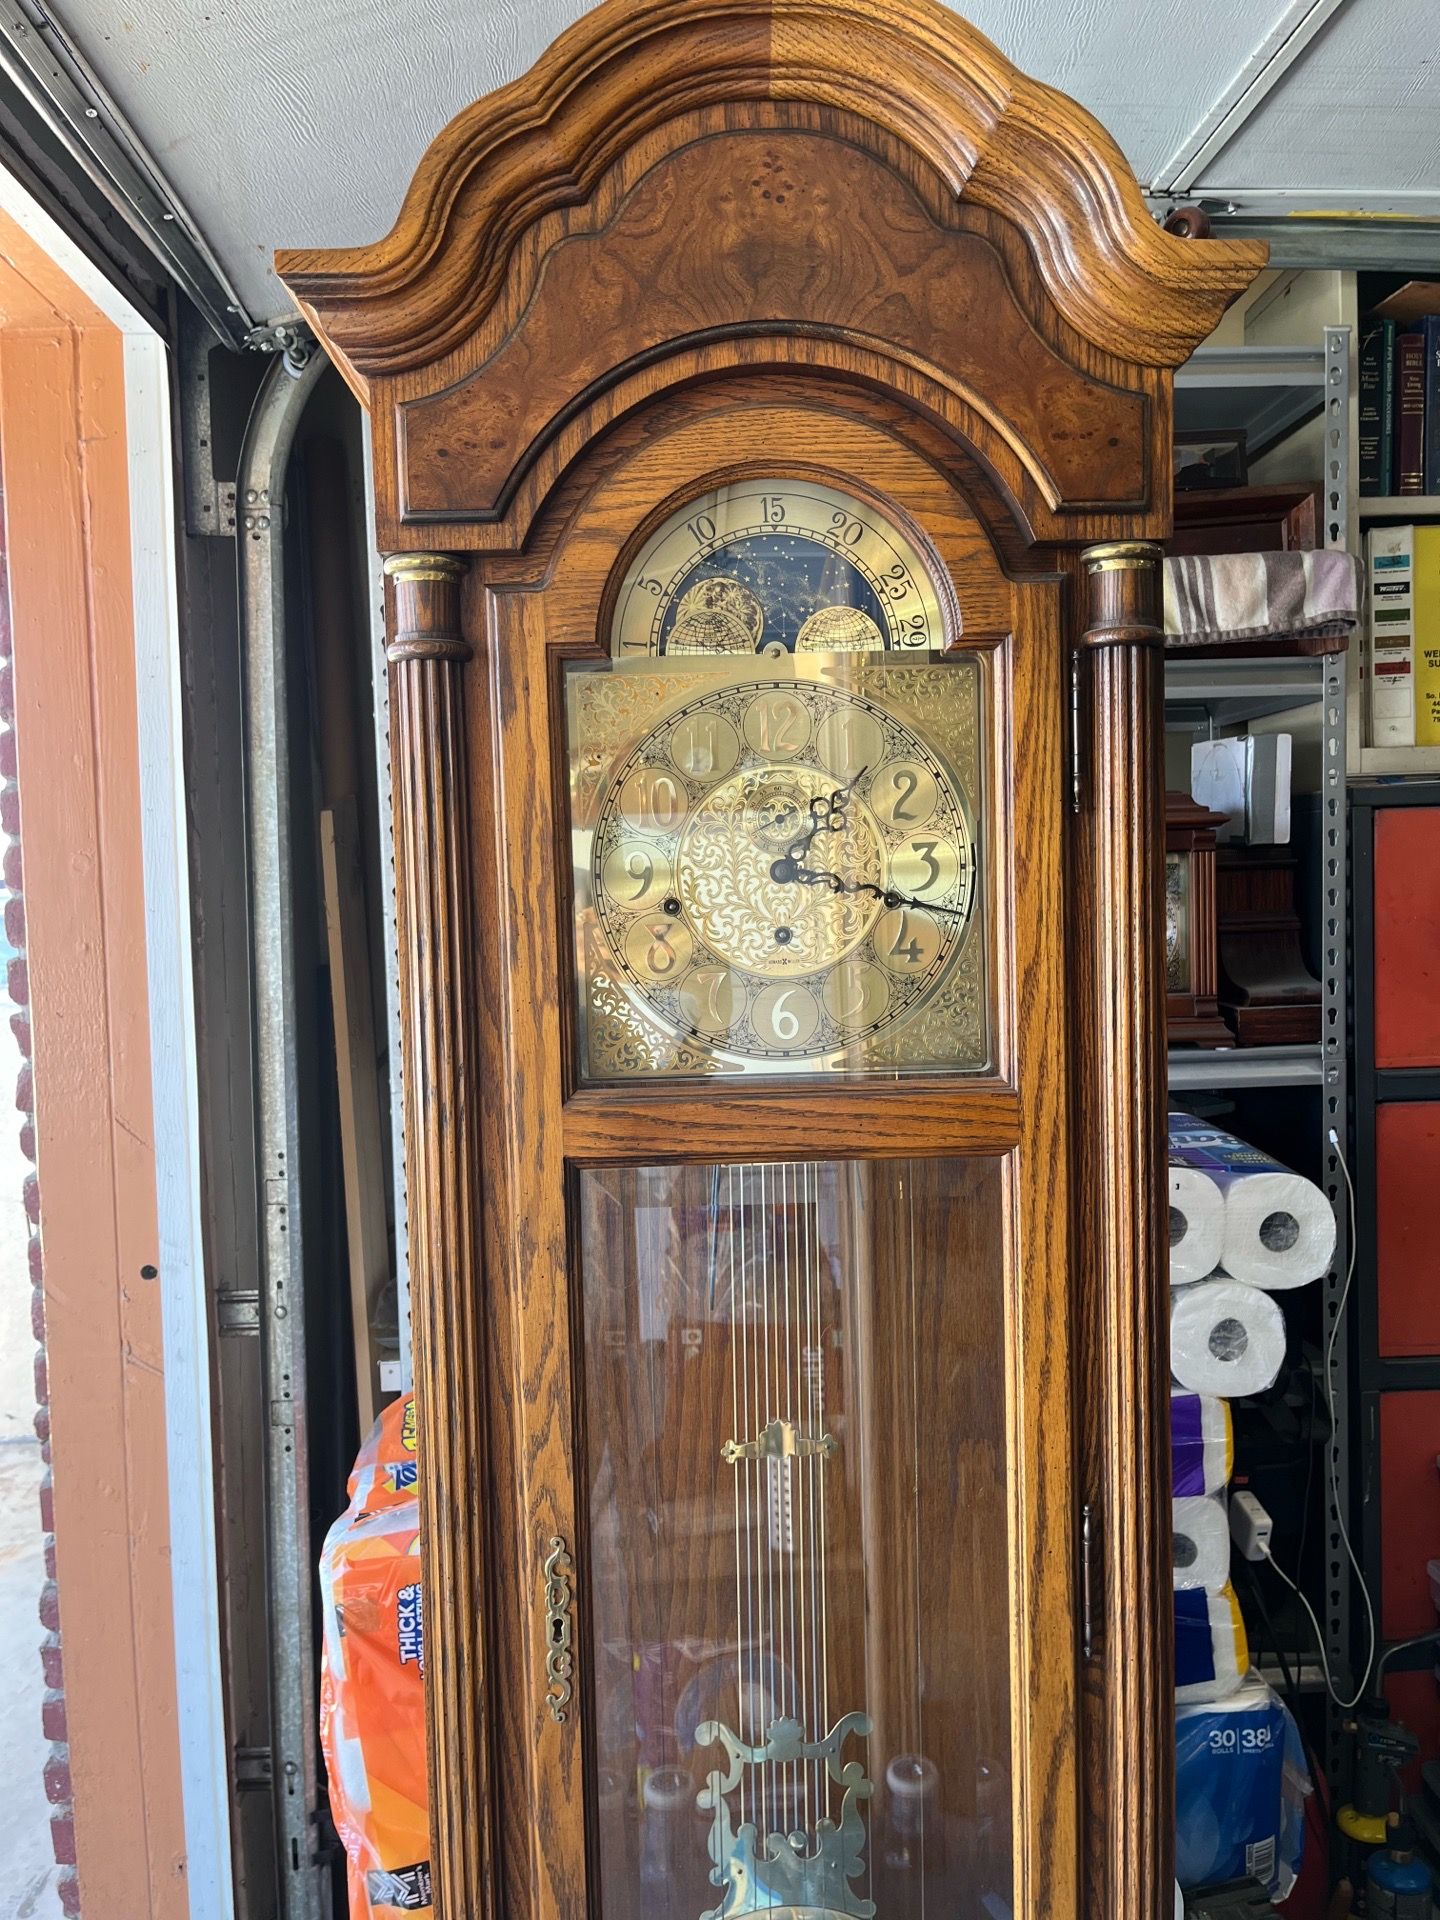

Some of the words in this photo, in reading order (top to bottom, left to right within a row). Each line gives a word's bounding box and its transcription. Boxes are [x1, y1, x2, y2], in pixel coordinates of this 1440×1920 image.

[1405, 352, 1423, 360] HOLY
[687, 515, 717, 546] 10
[760, 497, 786, 523] 15
[826, 511, 863, 547] 20
[638, 576, 664, 597] 5
[880, 564, 914, 600] 25
[622, 640, 649, 650] 1
[687, 720, 721, 774] 11
[755, 701, 799, 753] 12
[842, 716, 857, 770] 1
[632, 776, 679, 828] 10
[891, 770, 919, 822] 2
[624, 850, 654, 901] 9
[908, 841, 941, 892] 3
[645, 923, 676, 974] 8
[887, 910, 925, 963] 4
[698, 972, 728, 1024] 7
[771, 989, 800, 1041] 6
[844, 965, 871, 1020] 5
[397, 1583, 415, 1601] &
[398, 1602, 417, 1665] THICK
[1209, 1729, 1236, 1747] 30
